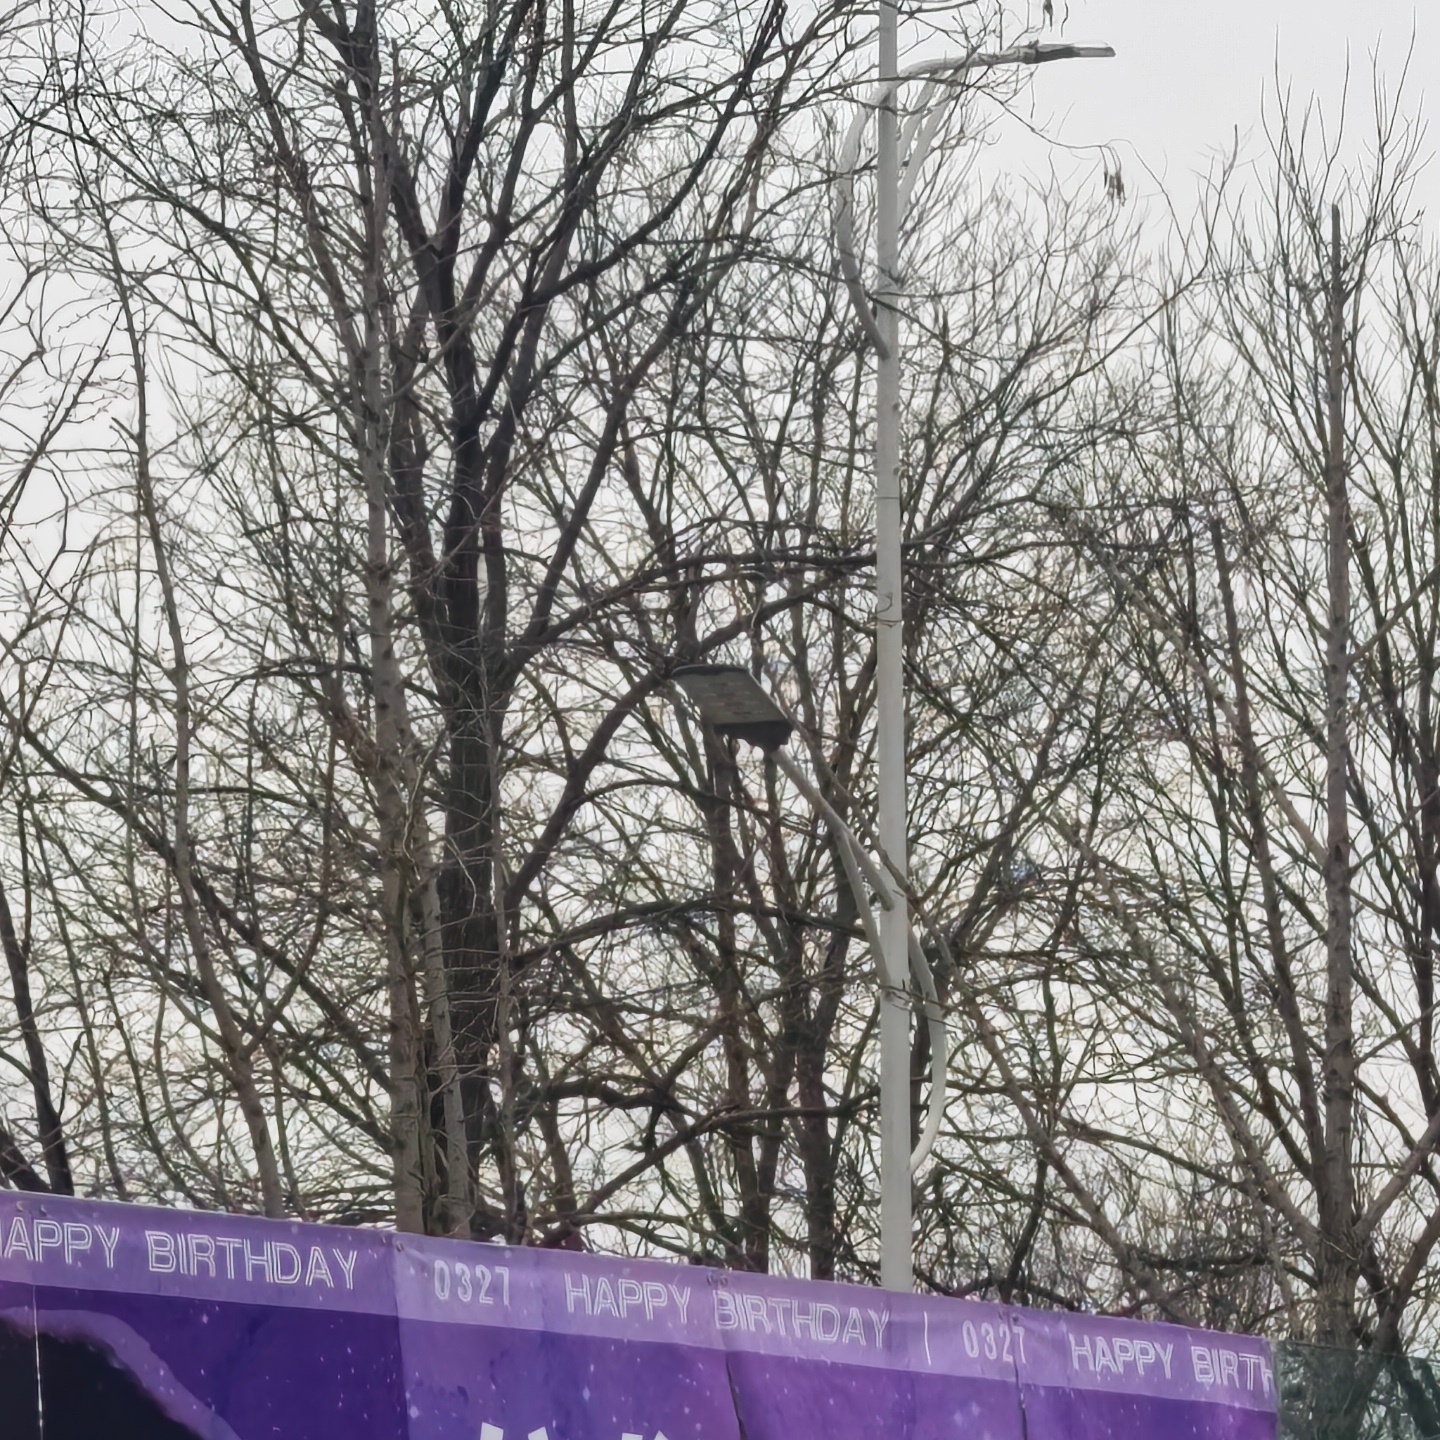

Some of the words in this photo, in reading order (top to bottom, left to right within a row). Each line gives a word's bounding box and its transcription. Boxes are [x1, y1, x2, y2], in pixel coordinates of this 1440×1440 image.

[145, 1229, 359, 1291] BIRTHDAY
[434, 1259, 511, 1307] 0327
[563, 1271, 692, 1324] HAPPY
[712, 1289, 890, 1348] BIRTHDAY
[962, 1320, 1027, 1365] 0327
[1068, 1332, 1174, 1380] HAPPY
